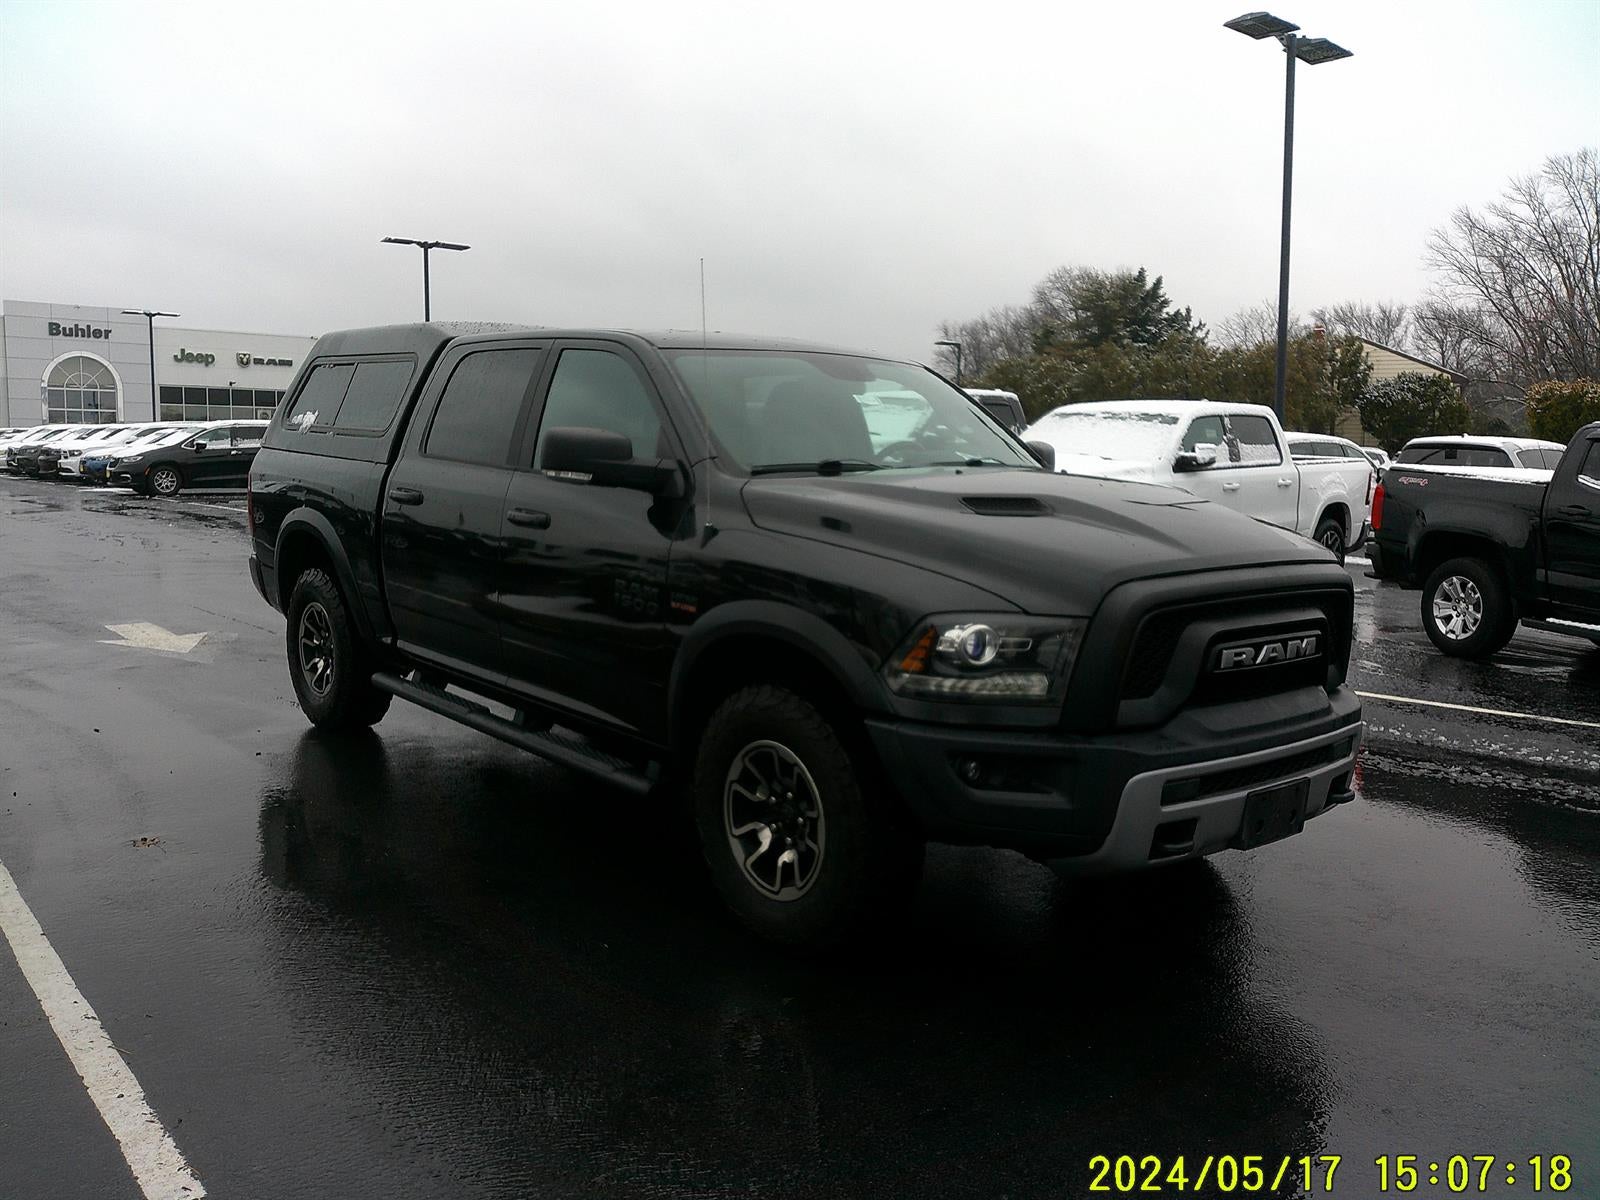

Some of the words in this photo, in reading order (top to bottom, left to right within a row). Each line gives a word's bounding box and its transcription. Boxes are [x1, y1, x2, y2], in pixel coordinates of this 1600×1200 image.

[48, 322, 112, 340] Buhler
[173, 348, 215, 367] Jeep
[252, 357, 293, 367] RAM
[615, 592, 659, 615] 1500
[1221, 637, 1316, 668] RAM
